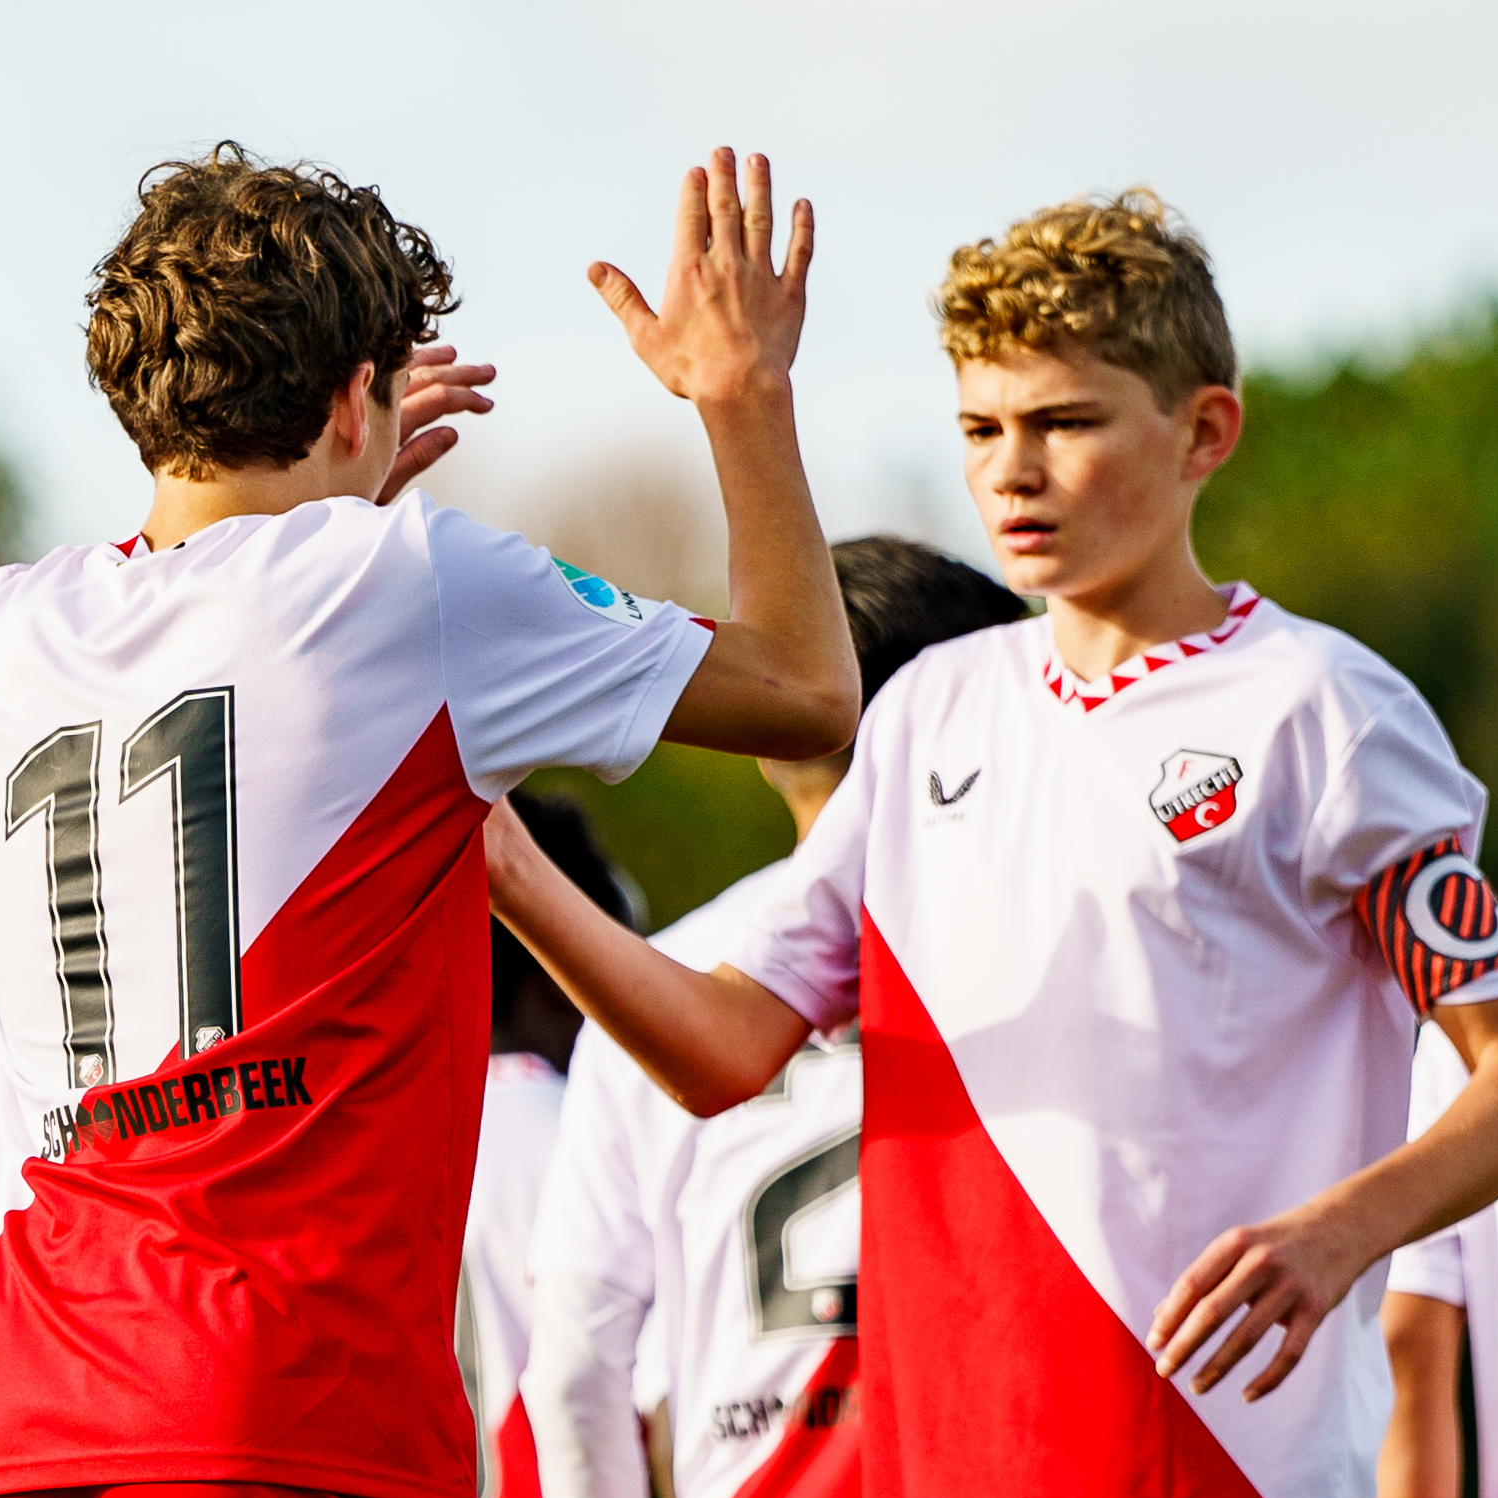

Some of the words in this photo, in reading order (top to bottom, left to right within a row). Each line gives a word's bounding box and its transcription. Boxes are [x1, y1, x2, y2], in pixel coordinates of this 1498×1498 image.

[1156, 765, 1239, 823] UTRECHT
[1194, 800, 1221, 829] C
[5, 684, 243, 1092] 11
